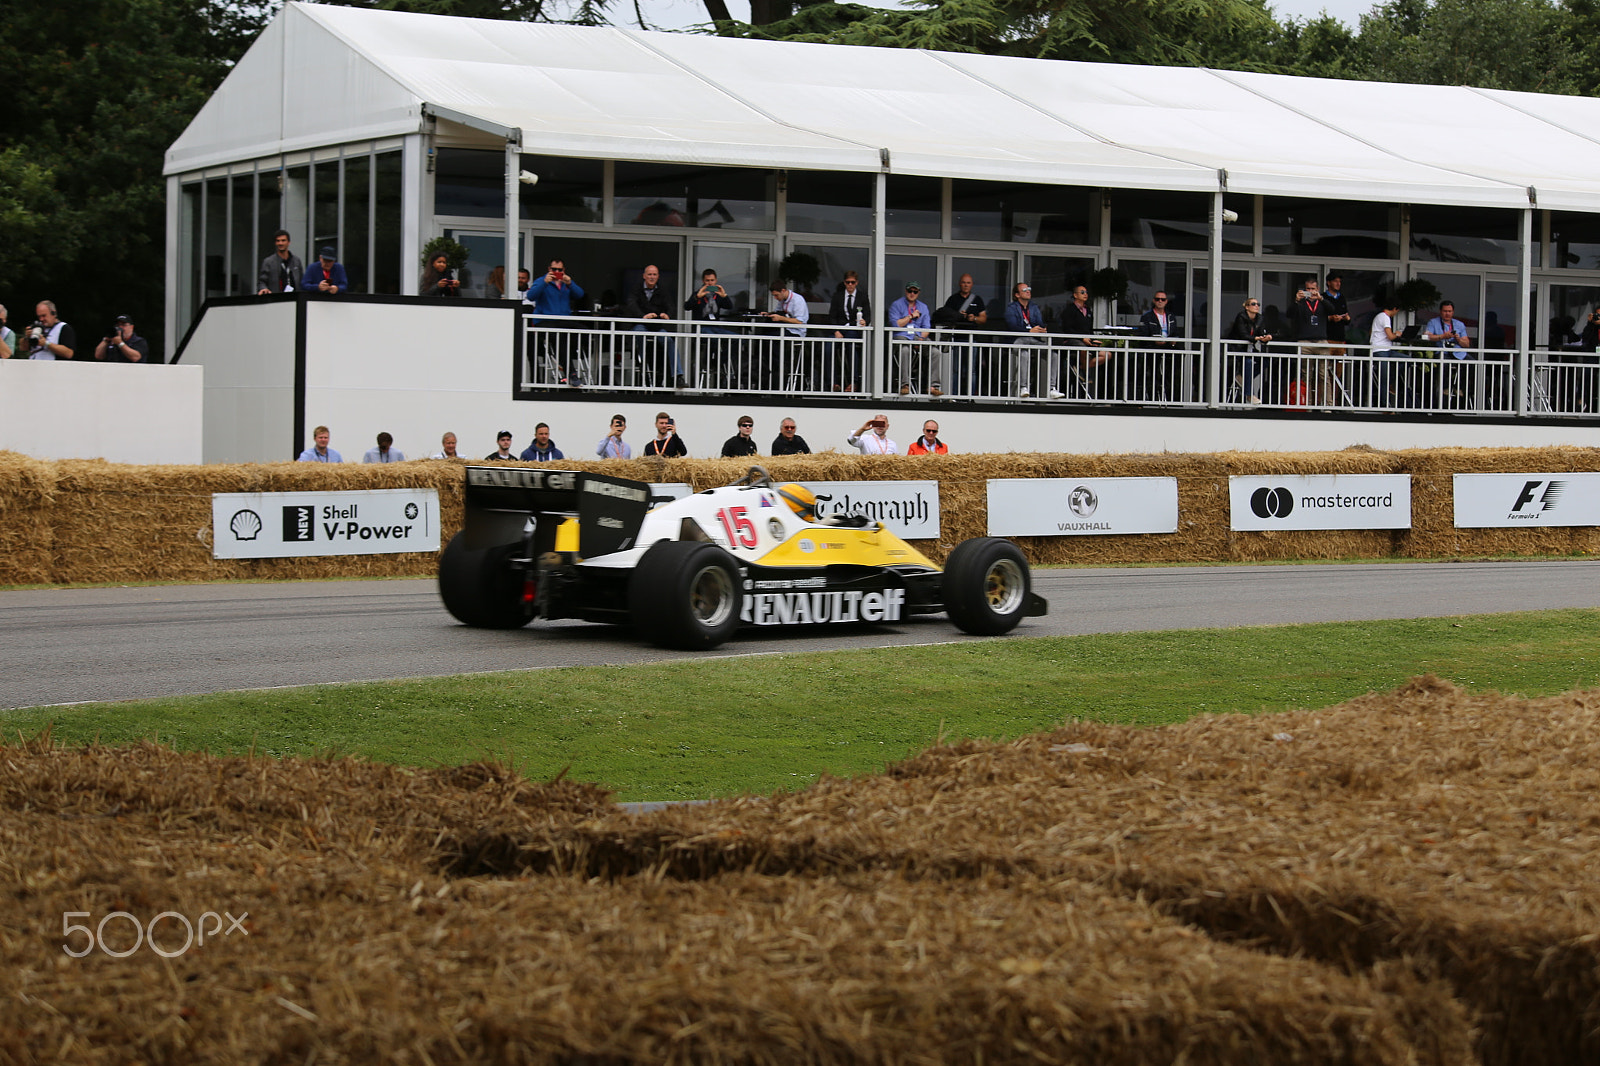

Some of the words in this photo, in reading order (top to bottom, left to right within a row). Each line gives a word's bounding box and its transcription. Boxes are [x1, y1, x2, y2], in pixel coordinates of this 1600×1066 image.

[814, 492, 928, 526] Telegraph
[1302, 492, 1392, 508] mastercard
[323, 505, 358, 519] Shell
[298, 507, 309, 539] NEW
[323, 522, 412, 540] V-Power
[716, 506, 758, 550] 15
[1057, 522, 1112, 531] VAUXHALL
